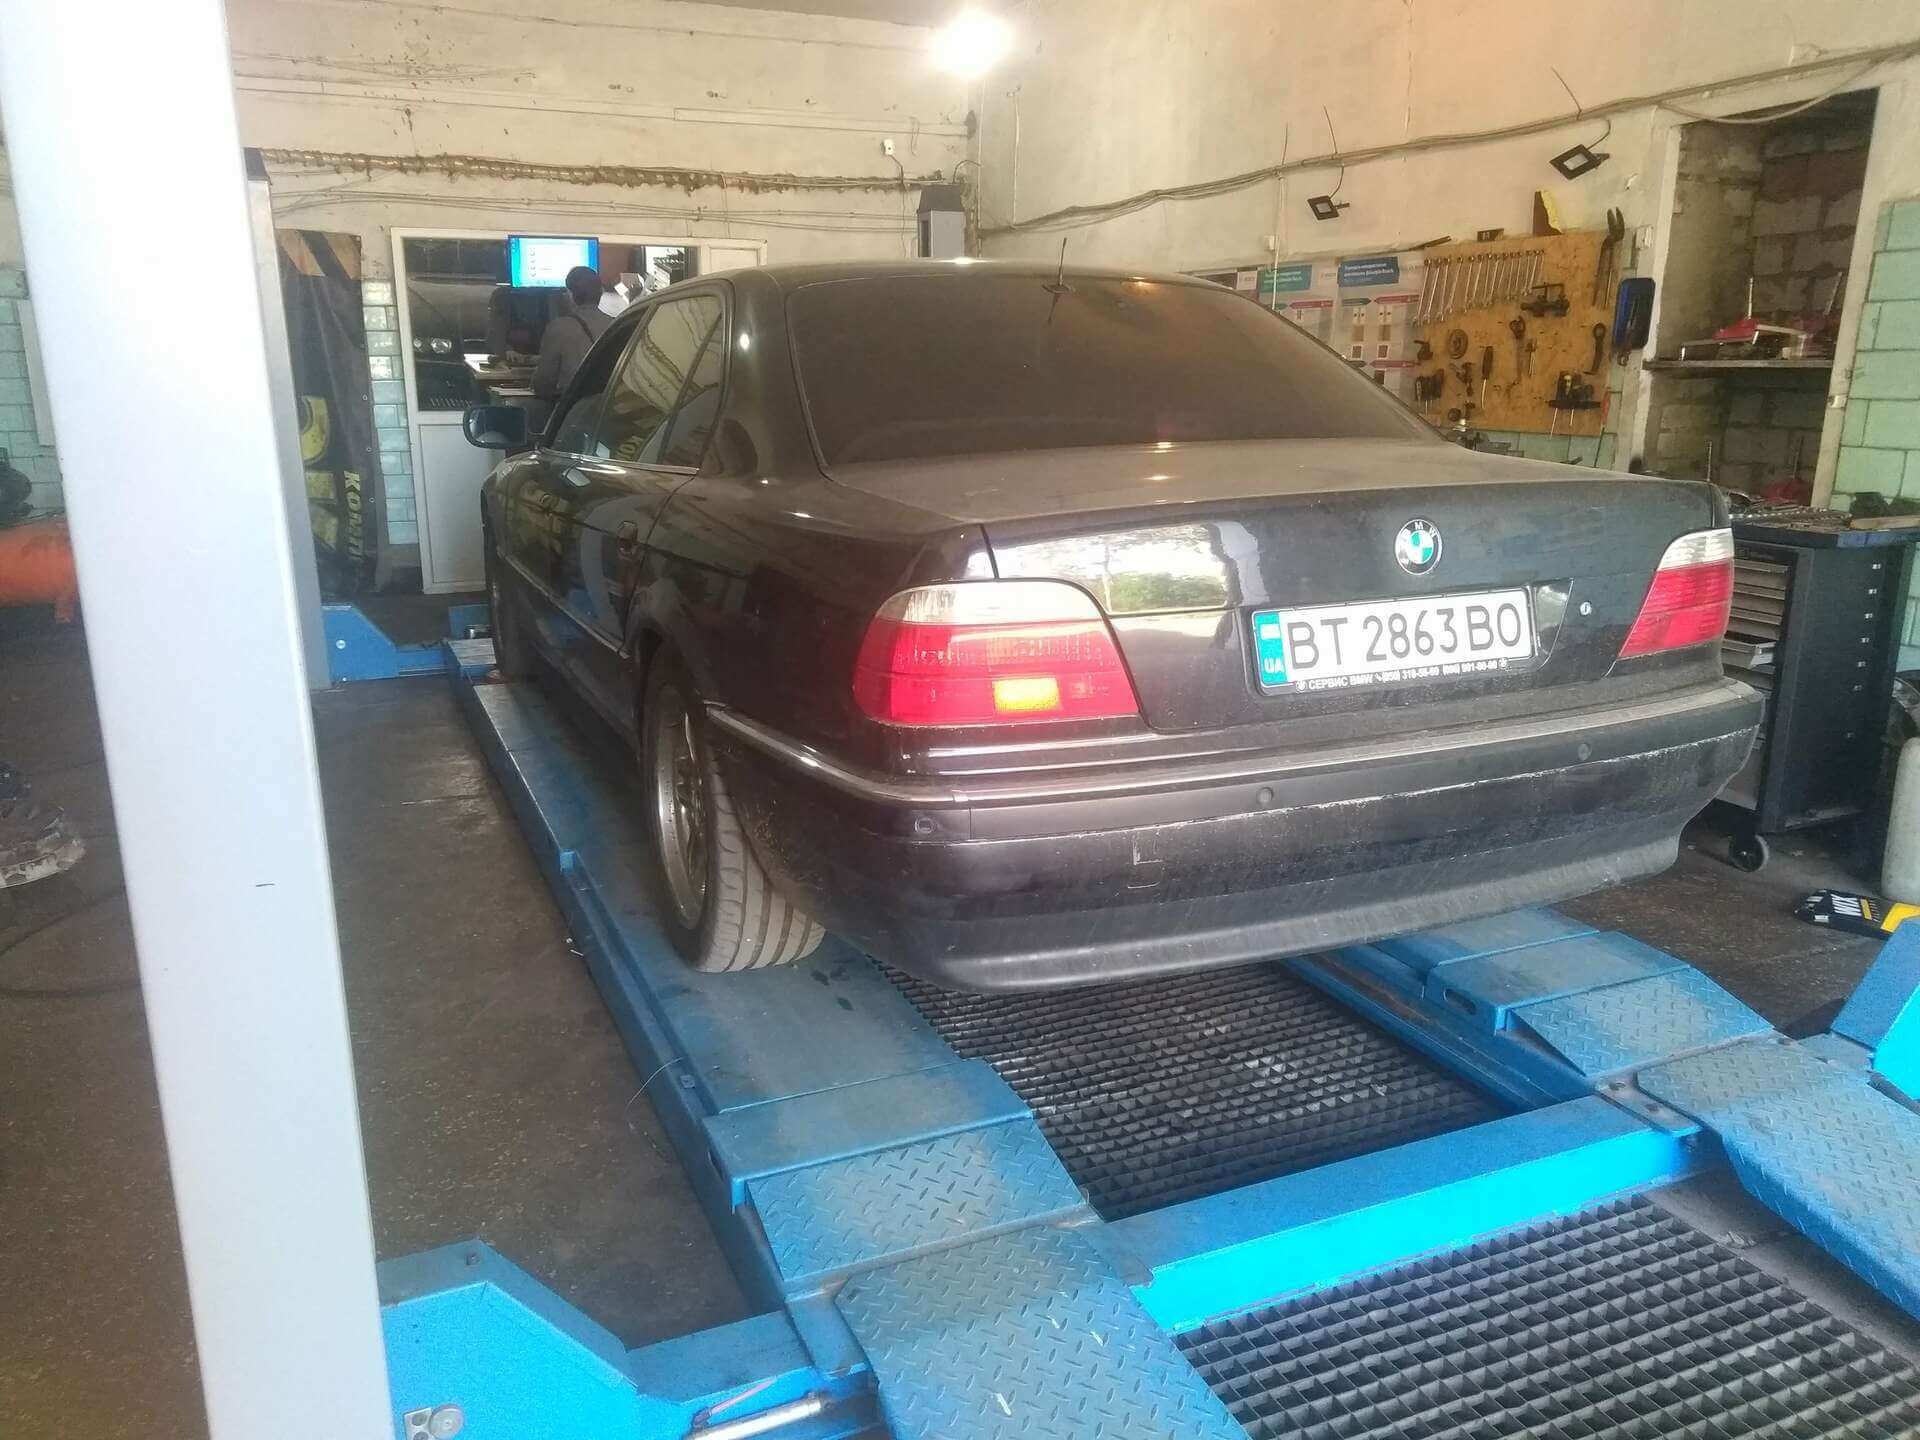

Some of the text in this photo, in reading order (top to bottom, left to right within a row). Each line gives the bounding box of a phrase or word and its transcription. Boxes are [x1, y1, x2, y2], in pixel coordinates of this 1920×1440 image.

[1401, 521, 1438, 539] BMW
[1287, 603, 1520, 669] BT 2863 BO
[1264, 658, 1285, 673] UA
[1308, 676, 1348, 690] СЕРВИС
